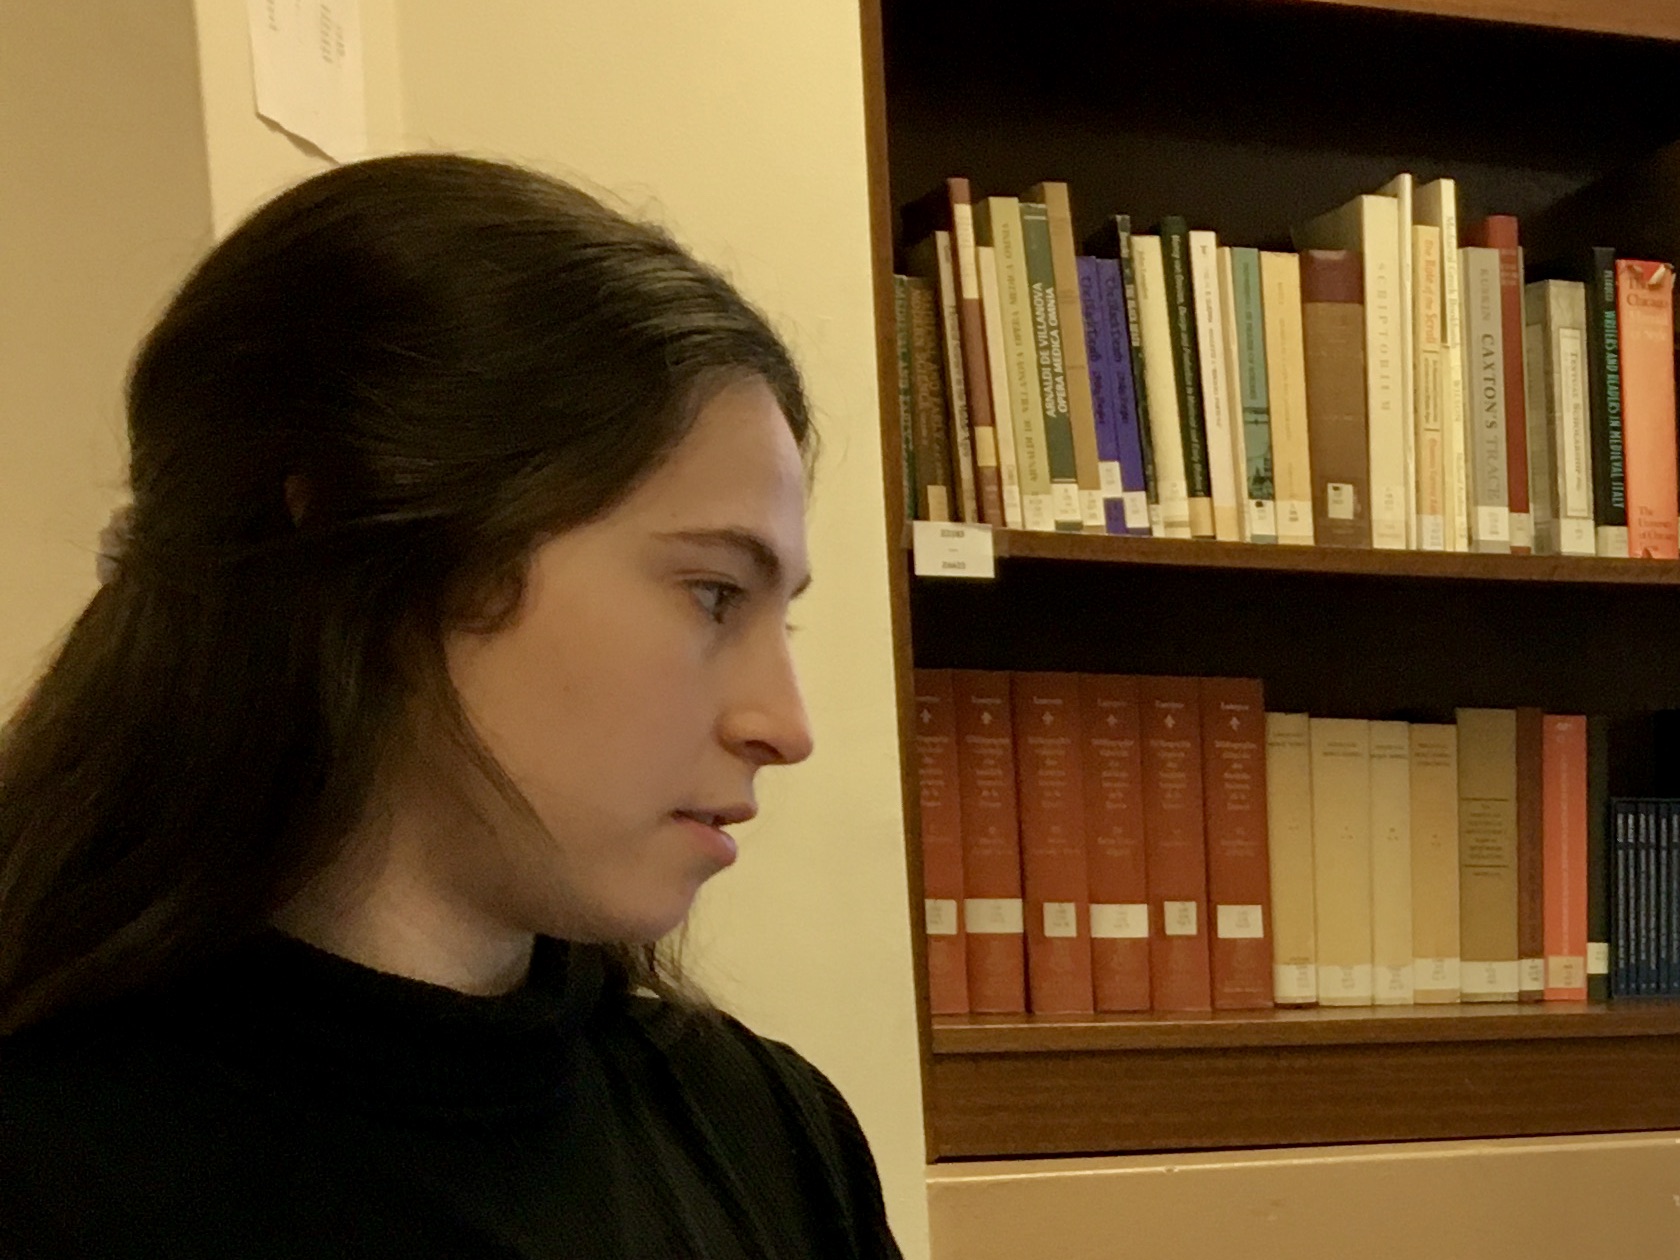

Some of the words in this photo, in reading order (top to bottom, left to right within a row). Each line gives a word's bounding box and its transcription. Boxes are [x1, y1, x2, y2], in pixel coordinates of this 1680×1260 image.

[1424, 239, 1435, 257] The
[1425, 260, 1438, 284] Role
[1032, 282, 1048, 347] VILLANOVA
[1045, 287, 1059, 327] OMNIA
[1425, 295, 1435, 312] the
[1425, 312, 1439, 344] Scroll
[1604, 310, 1619, 351] WRITERS
[1039, 349, 1051, 365] DE
[1050, 329, 1064, 373] MEDICA
[1605, 352, 1618, 372] AND
[1041, 367, 1056, 418] ARNALDI
[1054, 375, 1068, 414] OPERA
[1481, 333, 1499, 429] CAXTON'S
[1606, 373, 1621, 413] READERS
[1609, 415, 1620, 427] IN
[1486, 435, 1501, 500] TRACE
[1609, 430, 1624, 478] MEDIEVAL
[1611, 481, 1625, 509] ITALY
